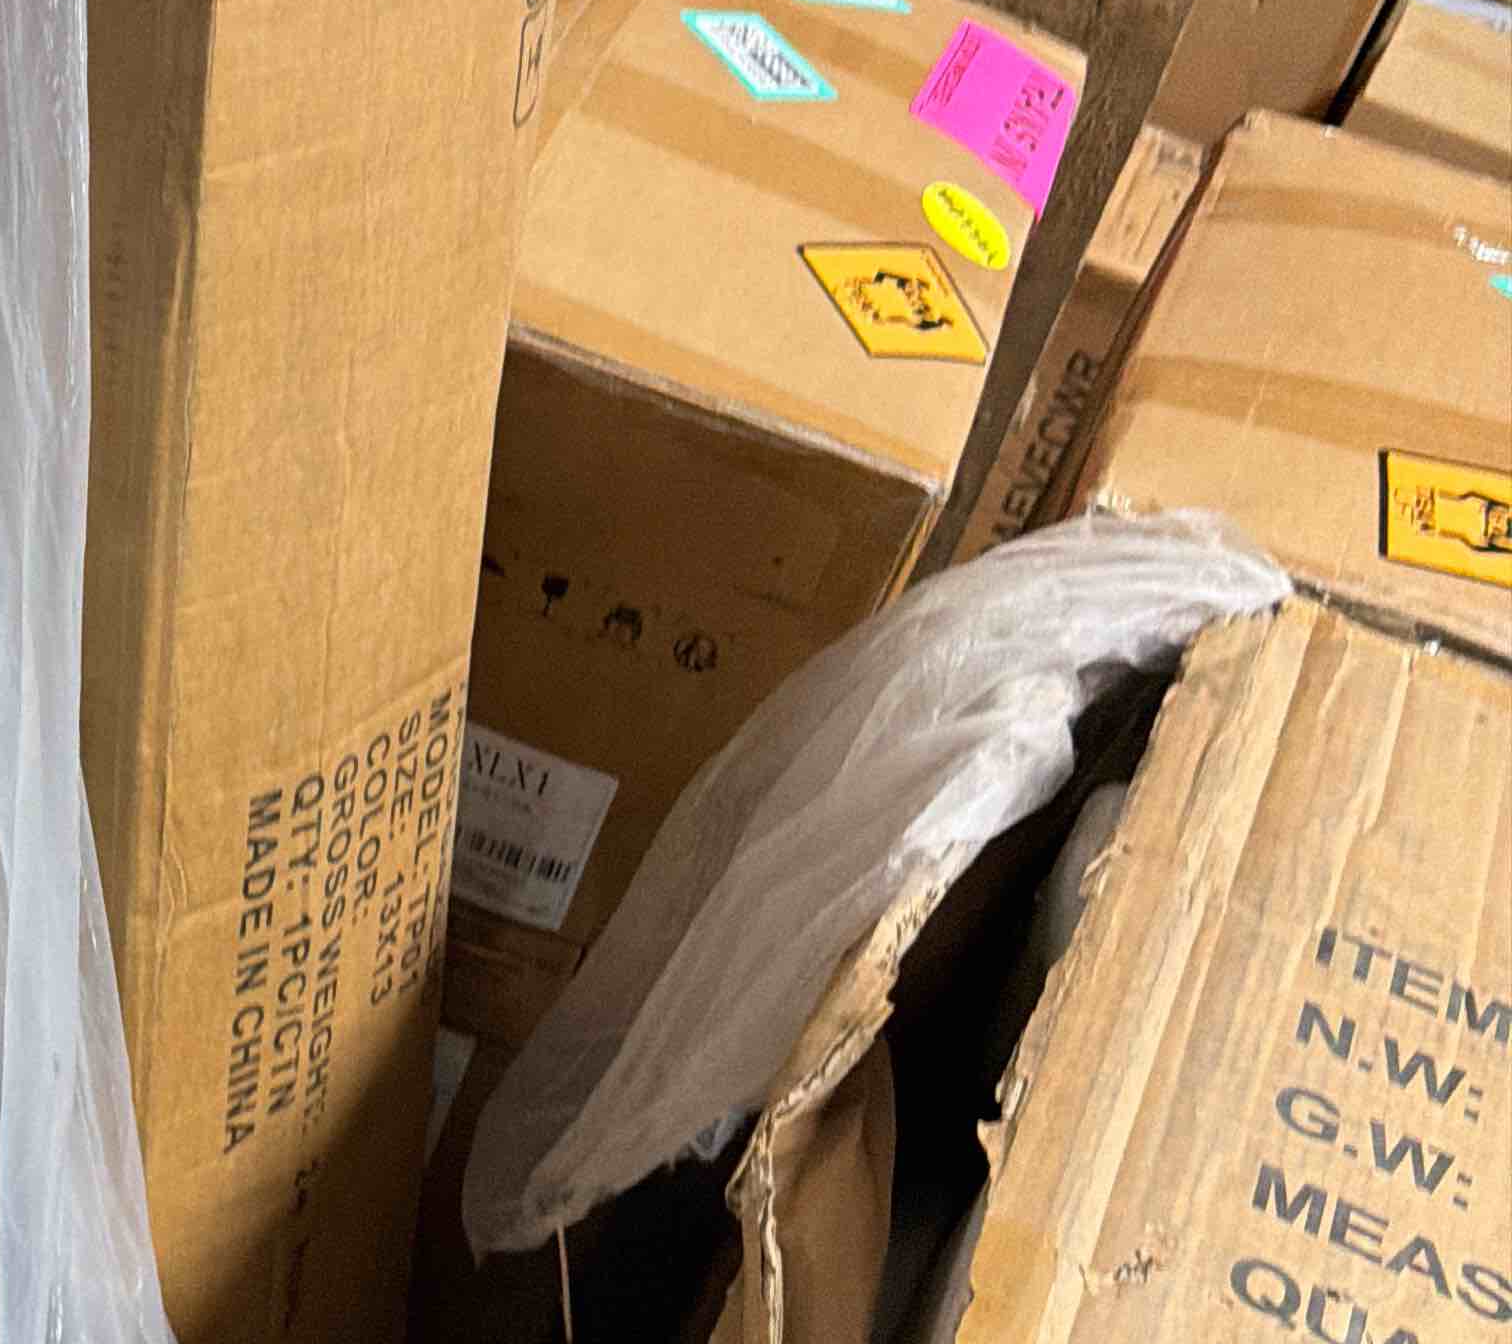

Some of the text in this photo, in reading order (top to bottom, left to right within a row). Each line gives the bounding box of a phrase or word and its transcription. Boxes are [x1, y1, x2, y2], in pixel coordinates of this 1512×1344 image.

[286, 773, 325, 891] QTY:
[321, 754, 359, 929] GROSS
[351, 732, 391, 927] COLOR:
[370, 711, 421, 1006] SIZE: 13X13
[413, 687, 451, 880] MODEL:
[224, 788, 283, 1155] MADE IN CHINA
[399, 881, 431, 993] TP01
[1295, 1000, 1484, 1125] N.W:
[1274, 1085, 1474, 1211] G.W:
[1250, 1162, 1512, 1323] MEAS
